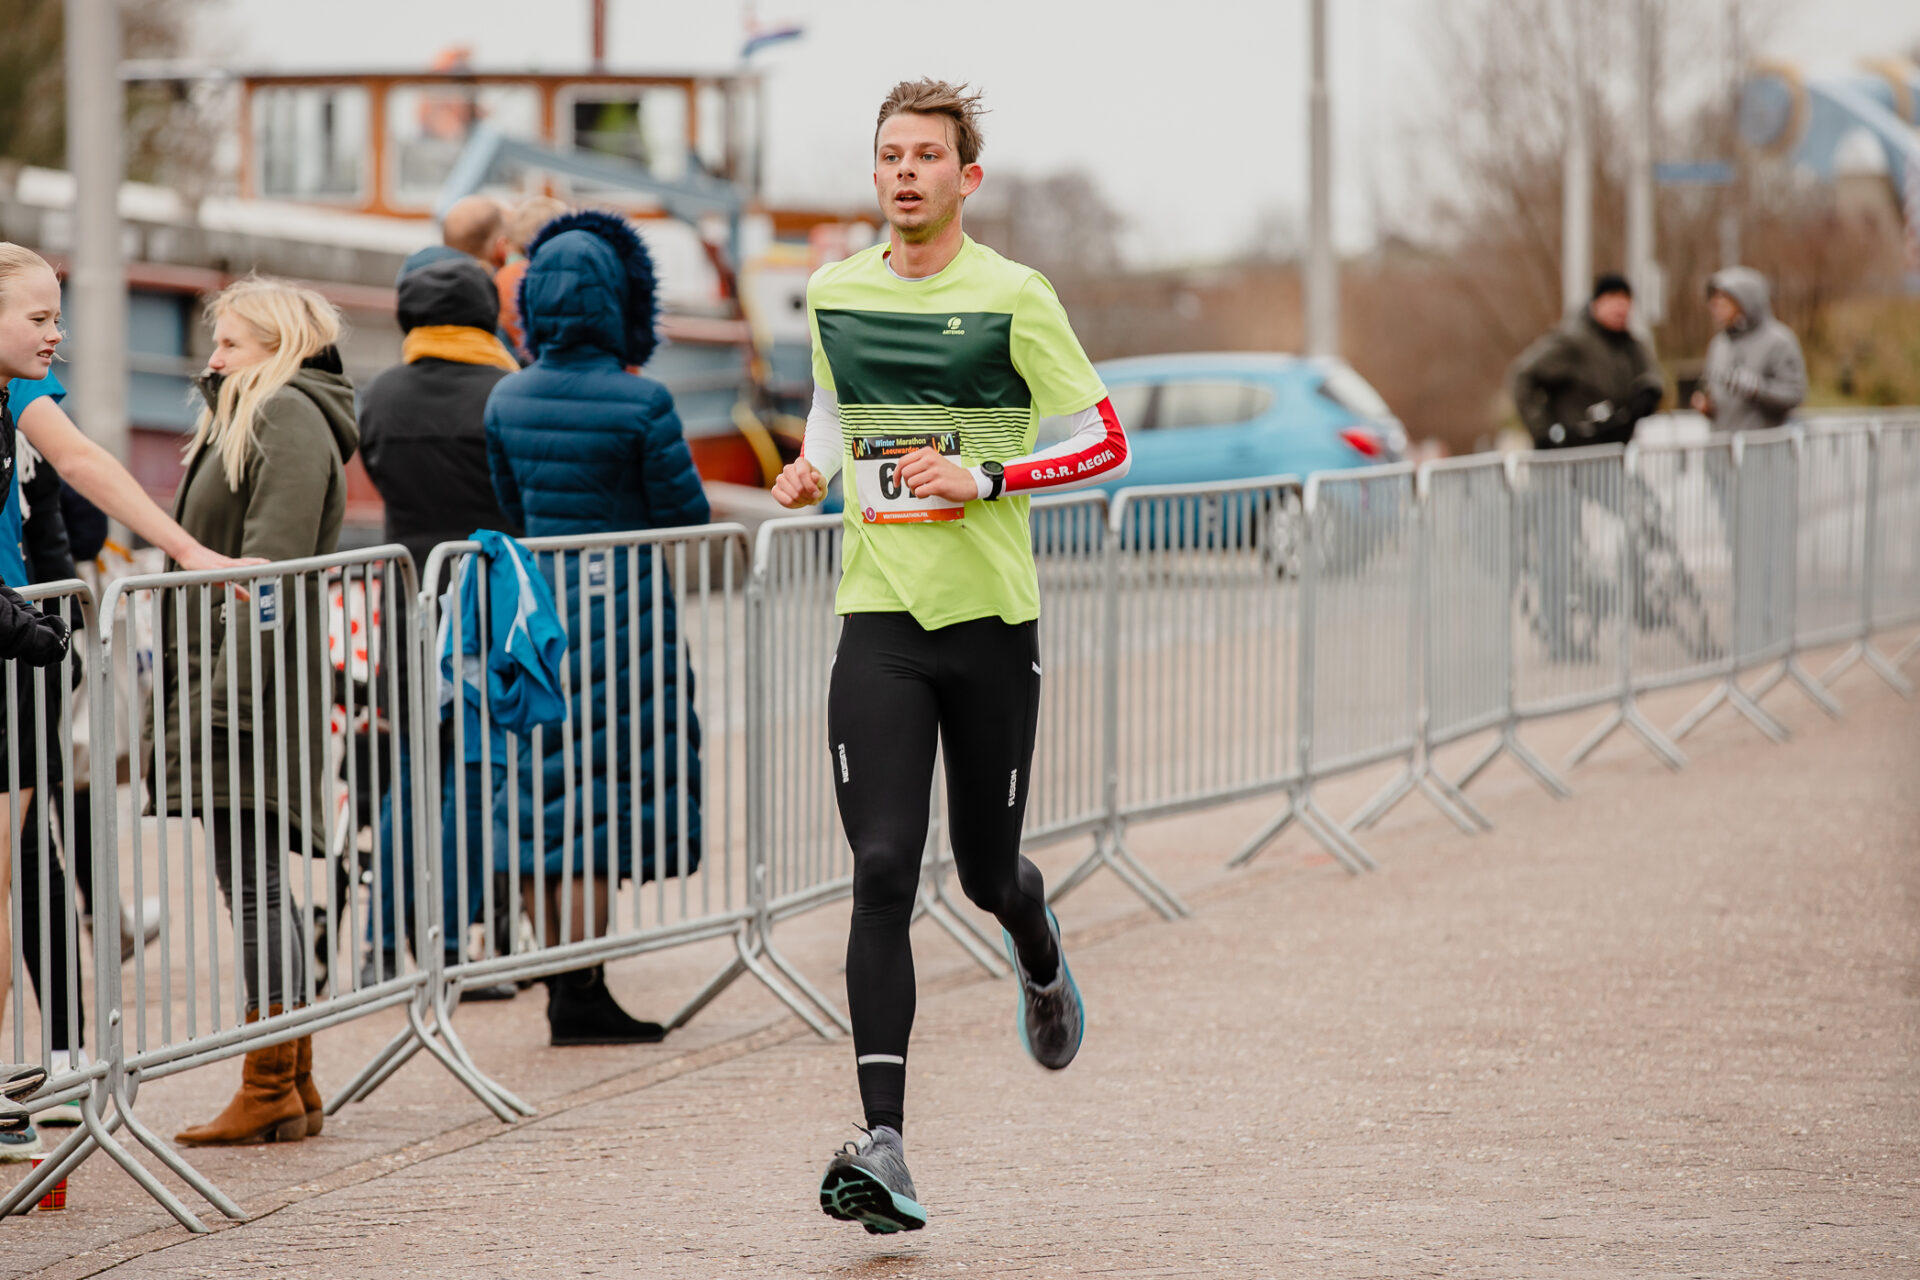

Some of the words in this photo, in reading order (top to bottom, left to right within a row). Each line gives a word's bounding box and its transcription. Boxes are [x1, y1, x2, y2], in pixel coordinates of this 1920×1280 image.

[896, 437, 926, 446] Marathon
[1031, 466, 1074, 480] G.S.R.
[838, 743, 849, 783] FUSION
[1008, 768, 1017, 807] FUSION
